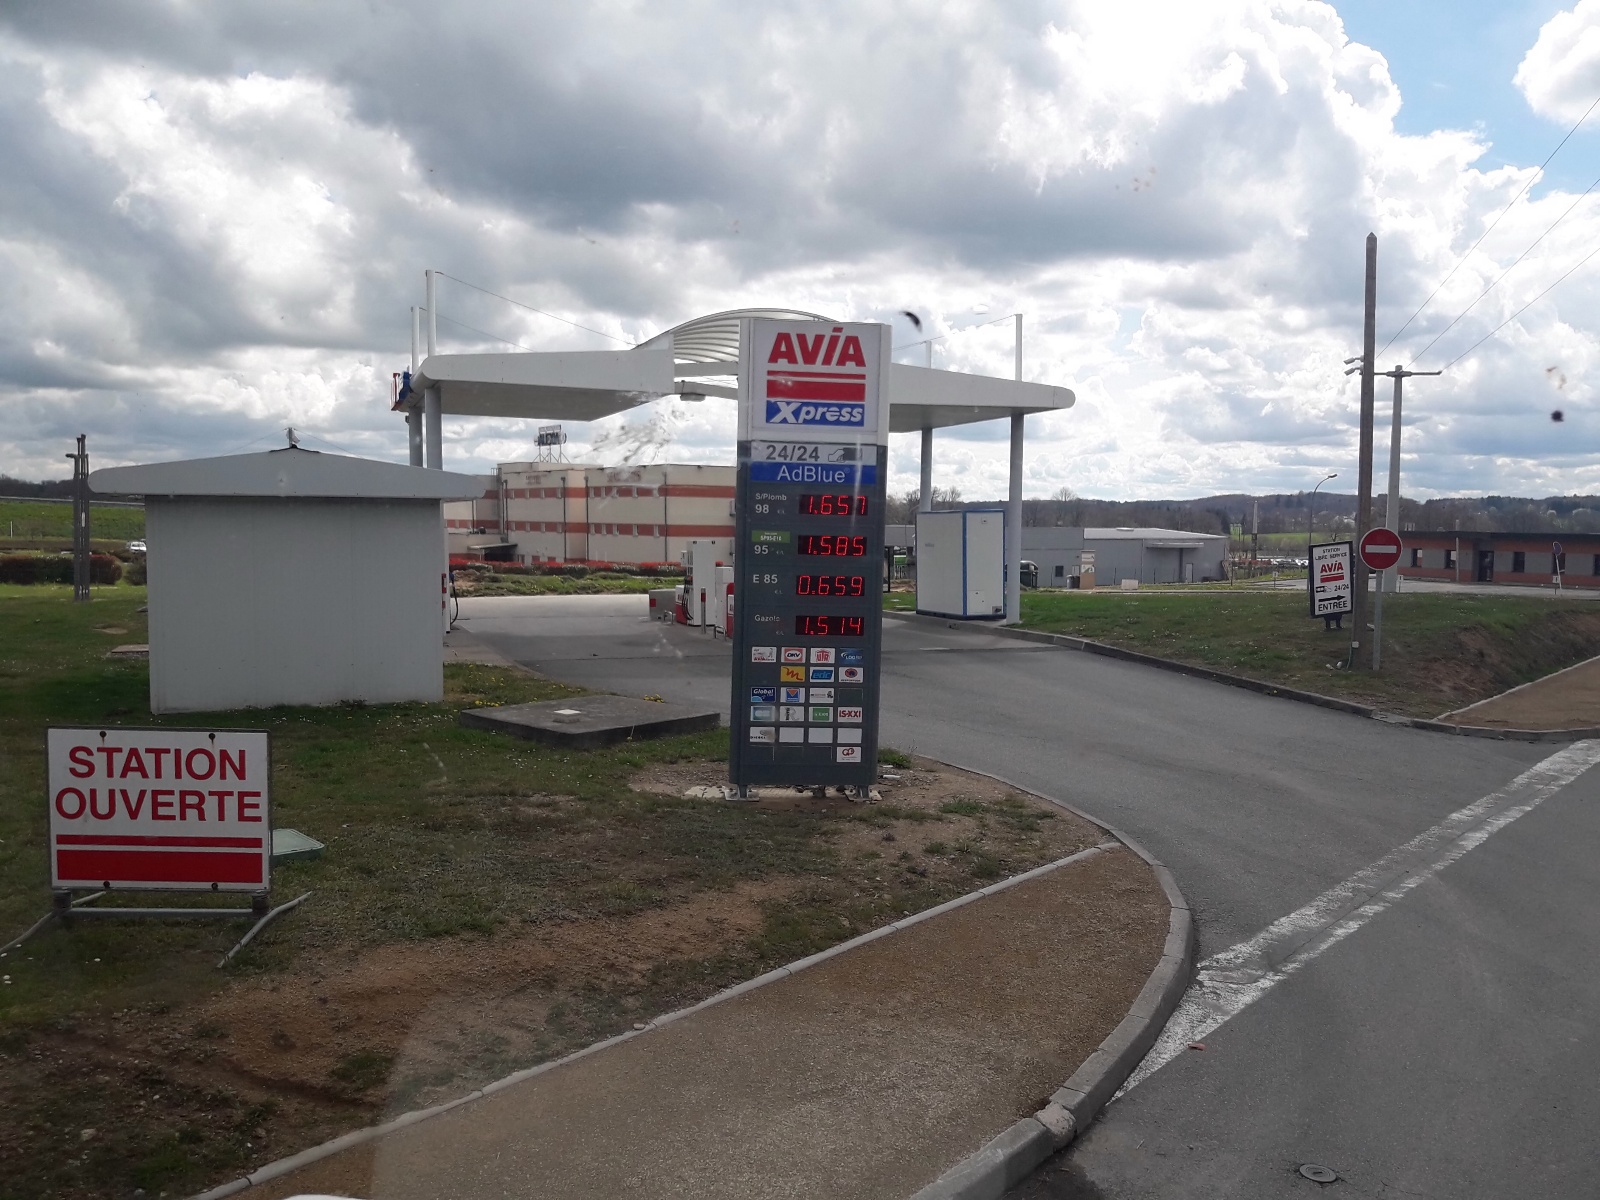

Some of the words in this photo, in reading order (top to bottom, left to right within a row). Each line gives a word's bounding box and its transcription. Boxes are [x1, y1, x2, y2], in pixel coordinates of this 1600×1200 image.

[769, 402, 863, 424] Xpress
[766, 444, 820, 462] 24/24
[777, 465, 846, 482] AdBlue
[755, 504, 770, 514] 98
[754, 545, 769, 555] 95
[808, 536, 864, 556] 1.585
[752, 574, 760, 583] E
[763, 574, 778, 584] 85
[798, 575, 863, 596] 0.659
[1334, 583, 1349, 592] 24/24
[804, 616, 861, 635] 1.514
[69, 746, 247, 780] STATION
[55, 787, 263, 822] OUVERTE
